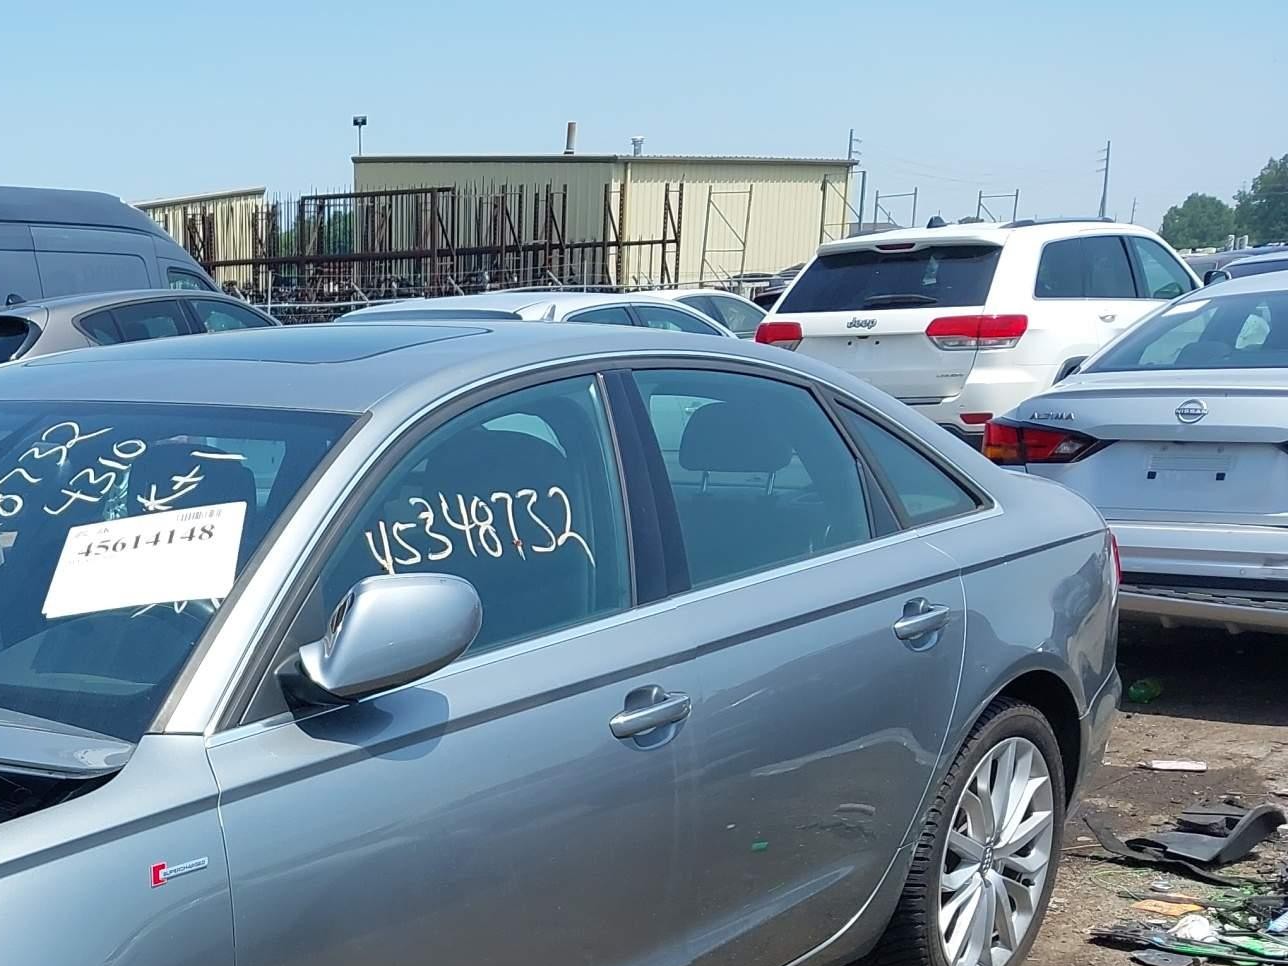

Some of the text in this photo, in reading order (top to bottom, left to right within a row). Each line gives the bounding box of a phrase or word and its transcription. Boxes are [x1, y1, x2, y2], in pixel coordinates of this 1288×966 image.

[846, 316, 878, 330] Jeep
[1174, 408, 1209, 417] NISSAN
[43, 439, 148, 516] 4310
[77, 523, 216, 558] 45614148
[364, 486, 597, 576] 45348732
